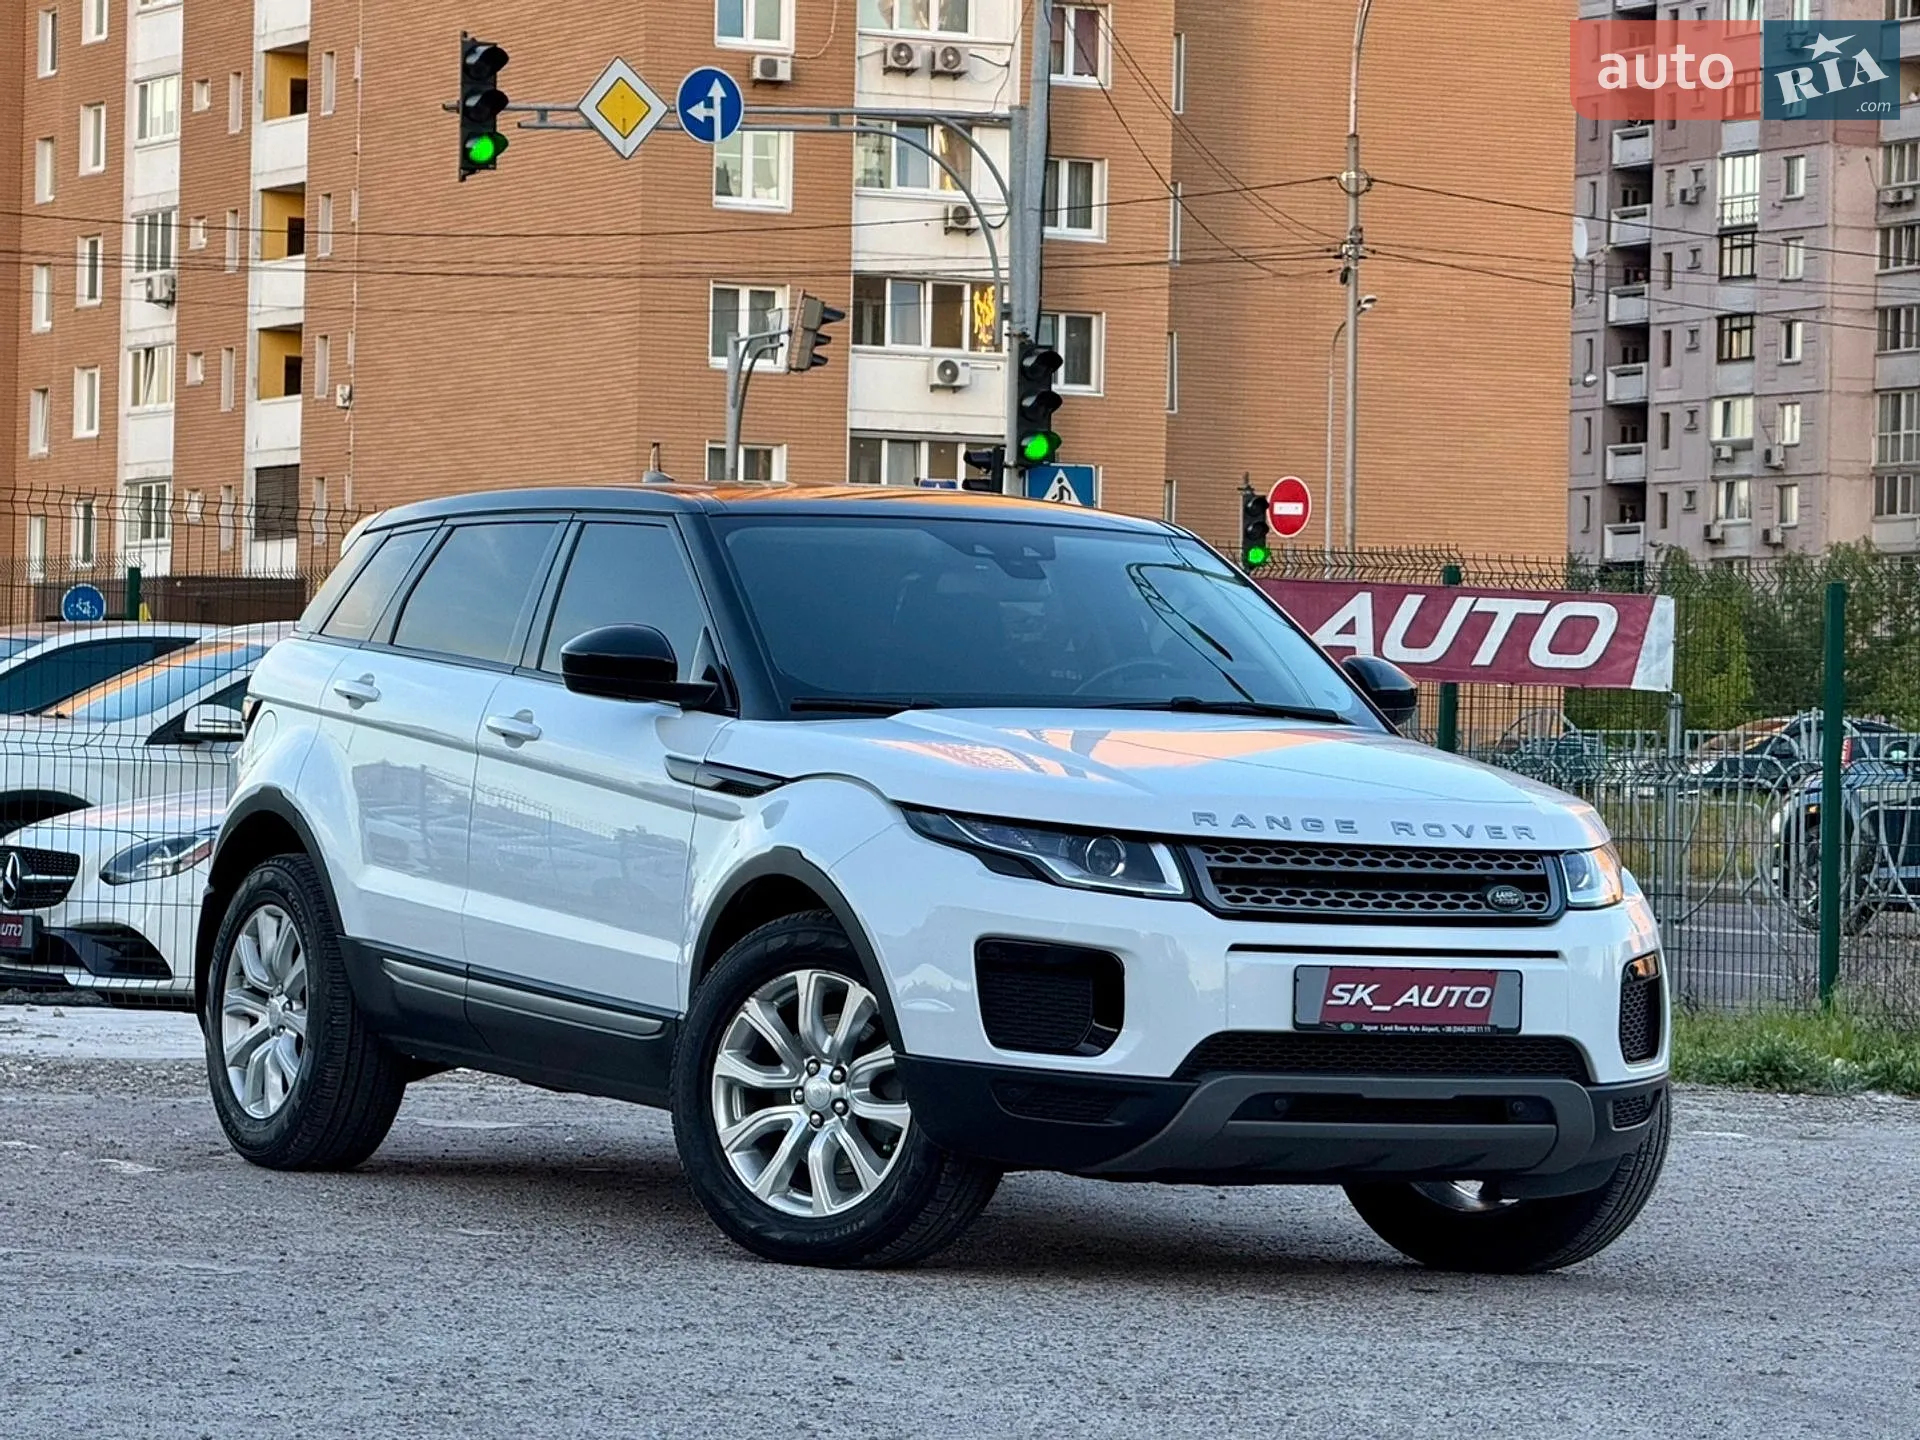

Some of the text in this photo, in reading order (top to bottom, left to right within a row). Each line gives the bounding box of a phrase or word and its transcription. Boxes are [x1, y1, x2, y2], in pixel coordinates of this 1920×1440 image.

[1311, 591, 1619, 670] AUTO
[1191, 811, 1537, 841] RANGE ROVER
[1325, 983, 1492, 1012] SK_AUTO
